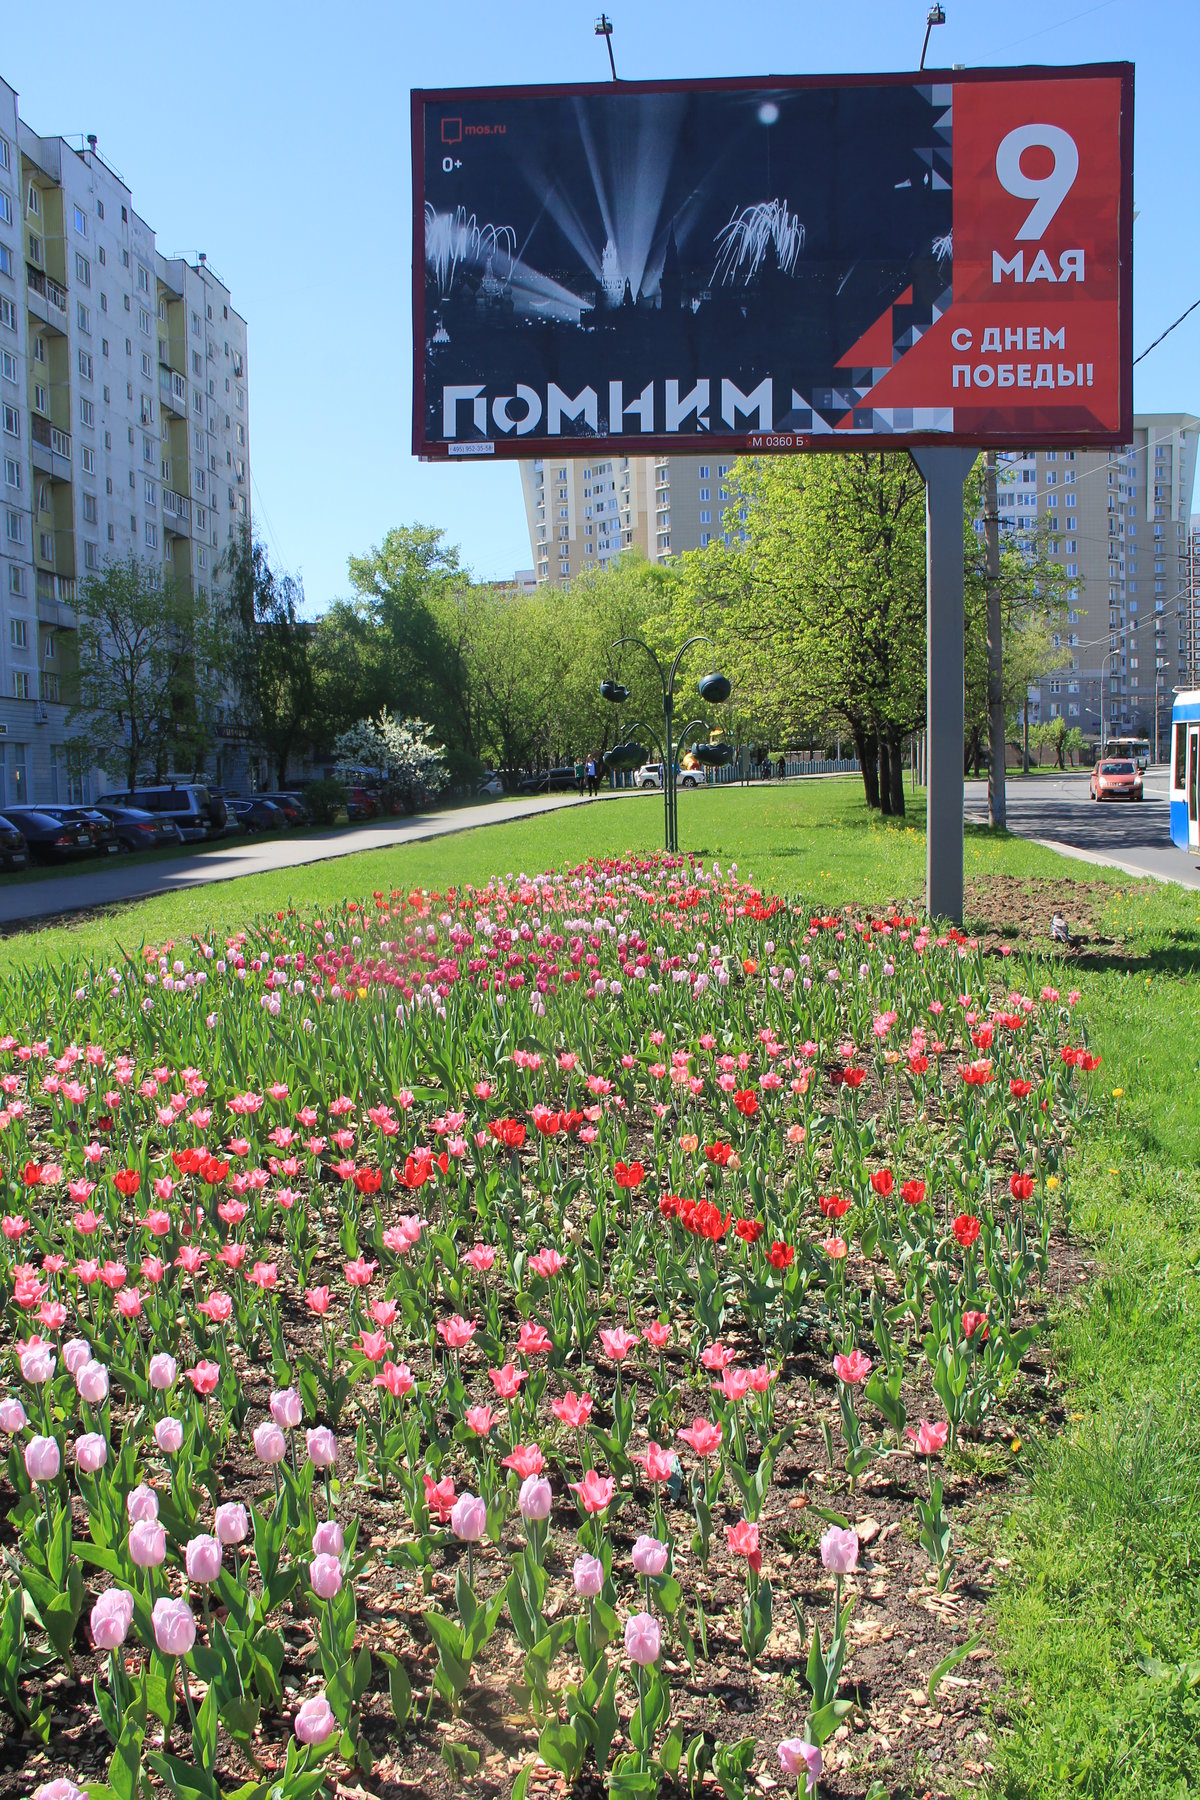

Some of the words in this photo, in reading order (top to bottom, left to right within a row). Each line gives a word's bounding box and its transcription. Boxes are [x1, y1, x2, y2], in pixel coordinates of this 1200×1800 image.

[465, 125, 507, 135] mos.ru
[442, 157, 463, 172] 0+
[995, 123, 1079, 241] 9
[992, 249, 1085, 283] МАЯ
[951, 328, 973, 351] С
[980, 327, 1065, 353] ДНЕМ
[952, 364, 1094, 389] ПОБЕДЫ!
[443, 378, 773, 437] ПОМНИМ
[752, 437, 762, 447] М
[766, 437, 792, 447] 0360
[796, 437, 804, 446] Б
